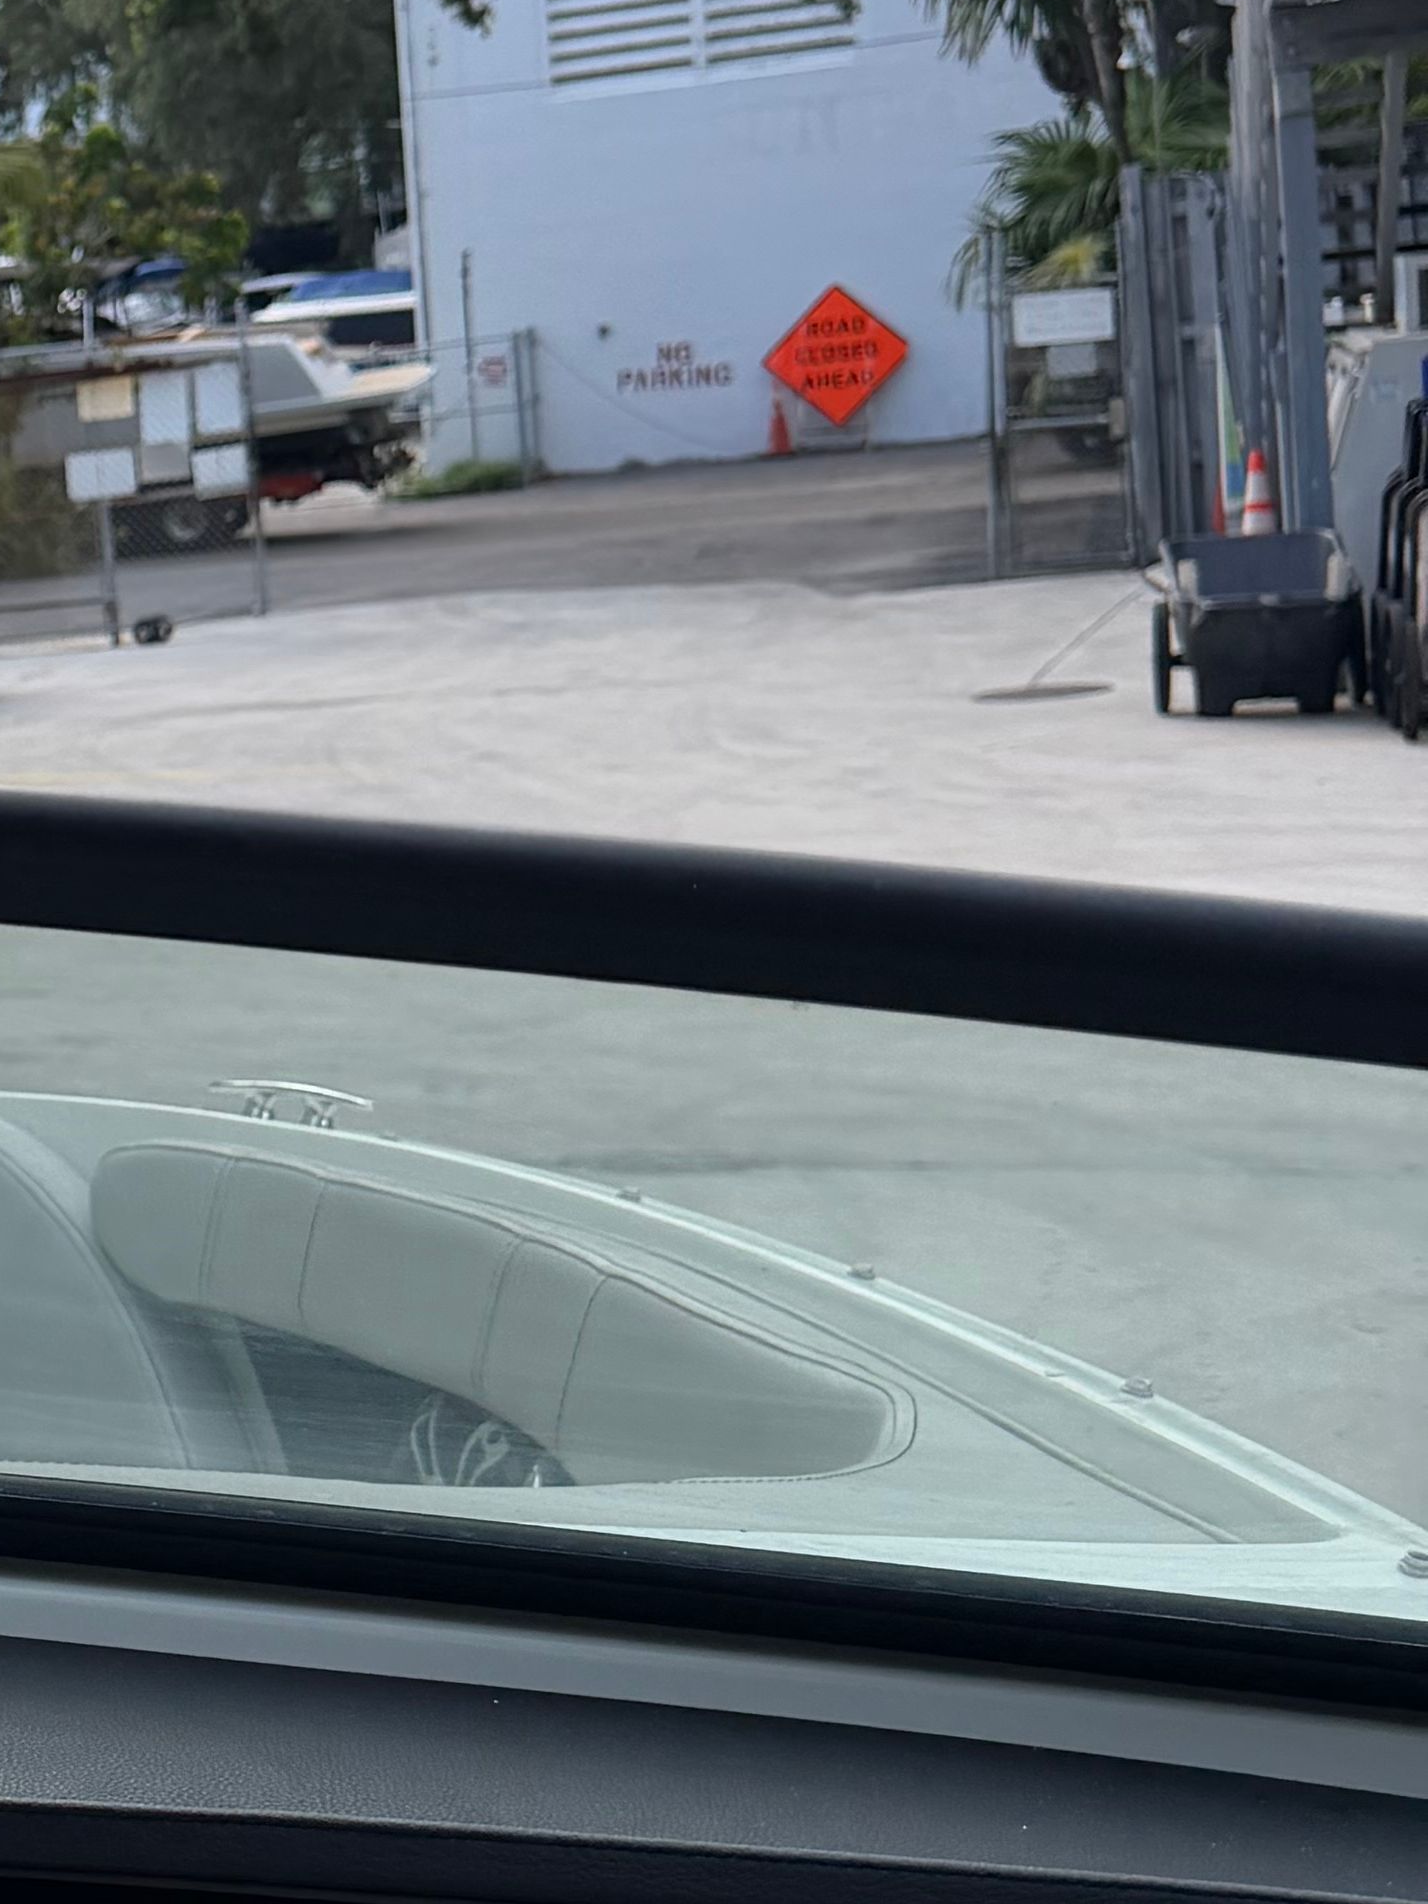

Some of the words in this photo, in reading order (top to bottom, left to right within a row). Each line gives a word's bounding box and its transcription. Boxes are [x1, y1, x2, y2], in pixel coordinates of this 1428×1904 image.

[807, 316, 866, 338] ROAD
[657, 342, 692, 366] NO
[795, 340, 879, 365] CLOSED
[617, 362, 733, 393] PARKING
[801, 369, 874, 392] AHEAD
